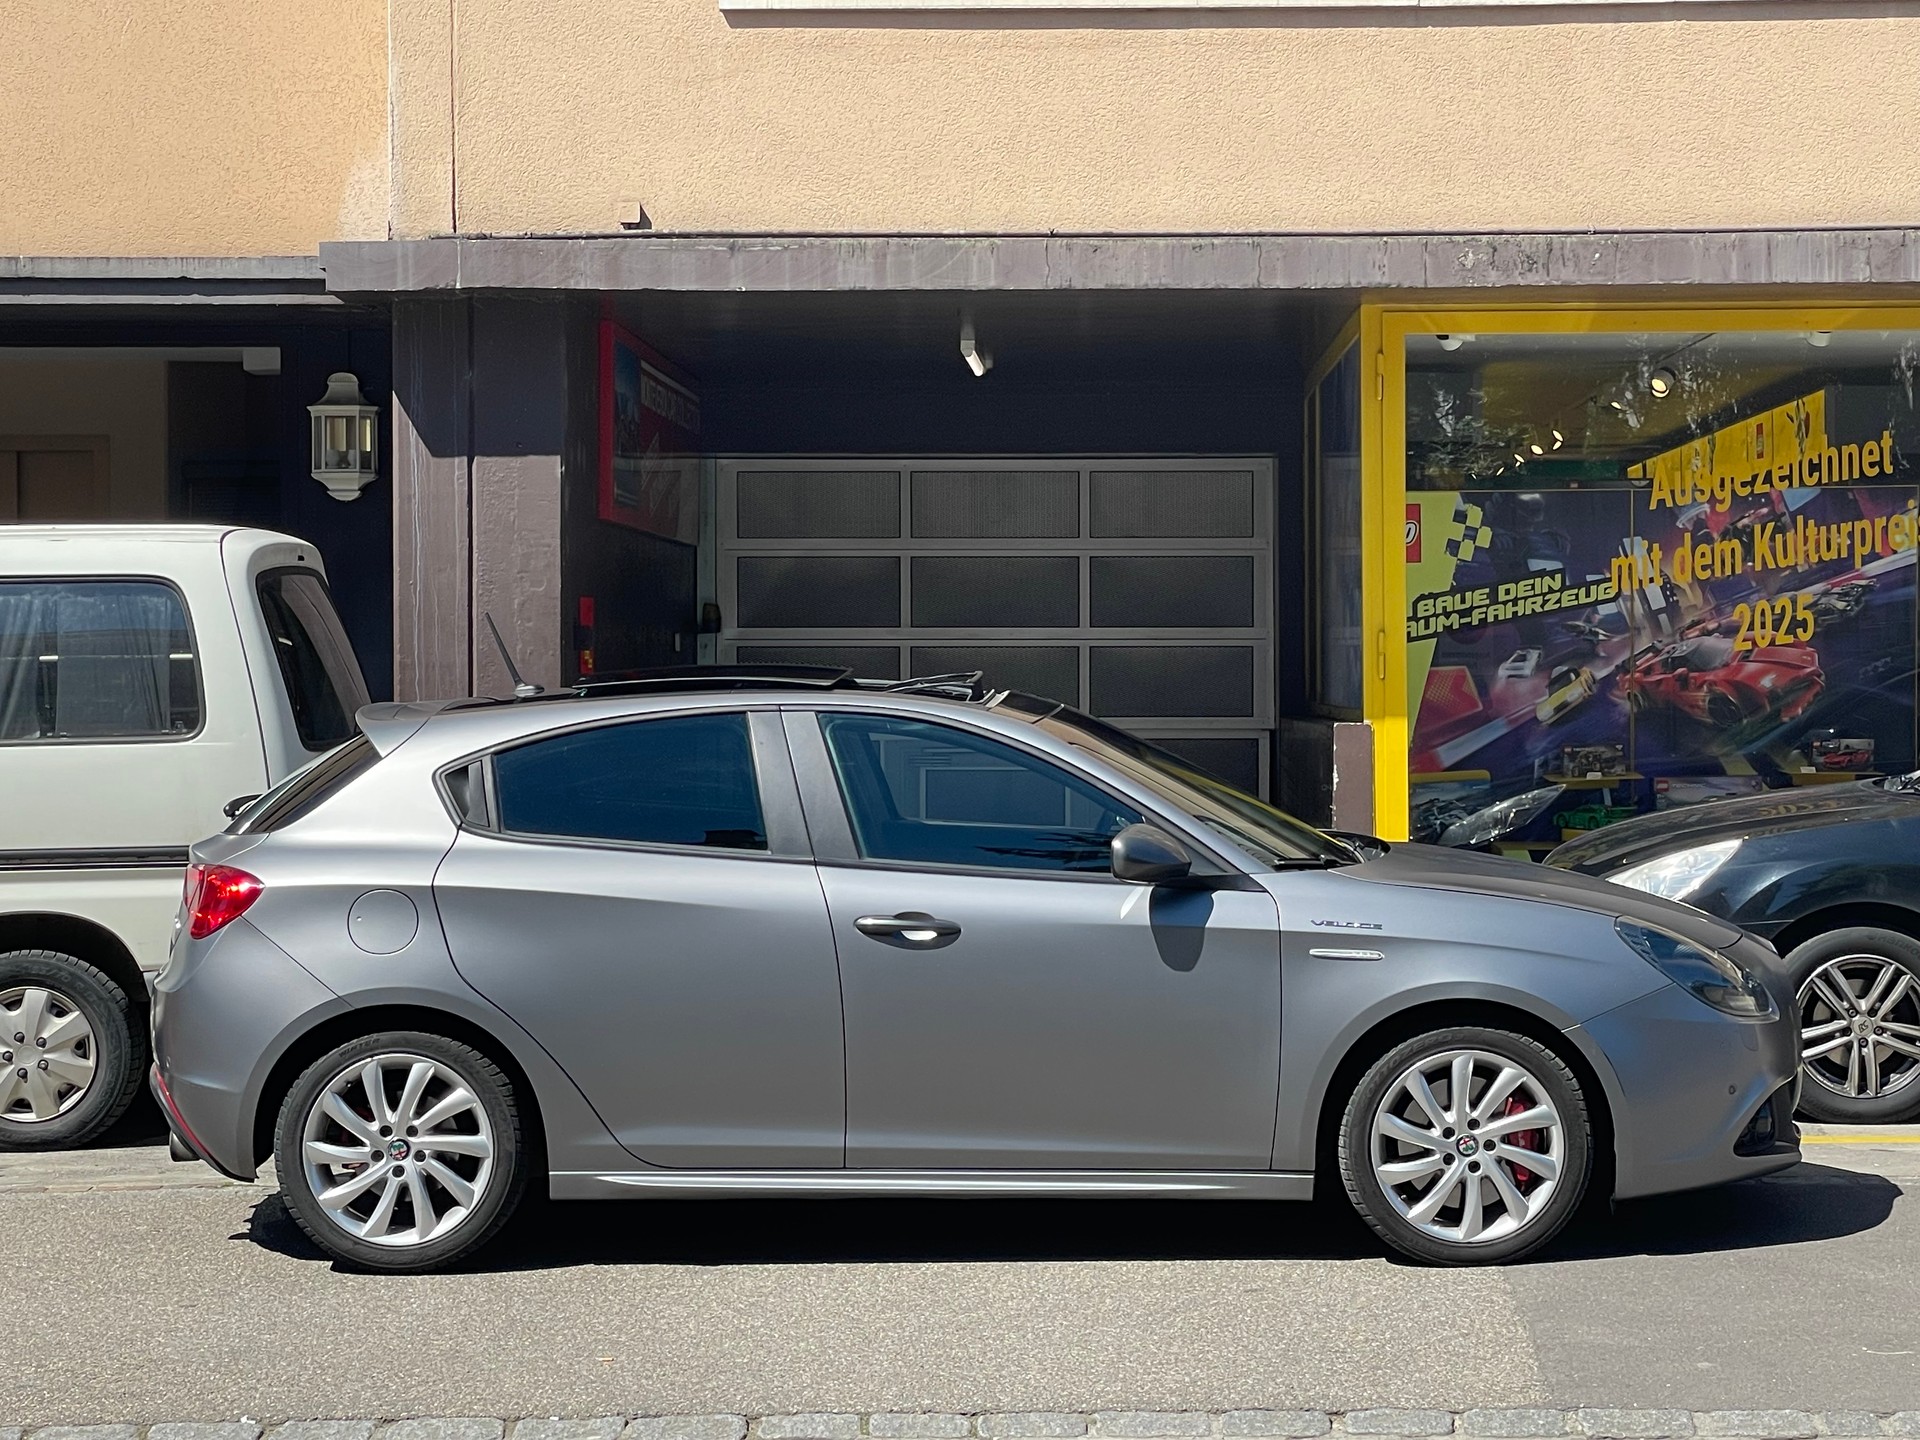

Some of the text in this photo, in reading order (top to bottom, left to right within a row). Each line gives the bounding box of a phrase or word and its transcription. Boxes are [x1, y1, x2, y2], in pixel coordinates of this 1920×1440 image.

[1650, 430, 1893, 512] Ausgezeichnet
[1611, 499, 1920, 593] mit dem Kulturprei
[1417, 573, 1562, 618] BAUE DEIN
[1733, 594, 1815, 651] 2025
